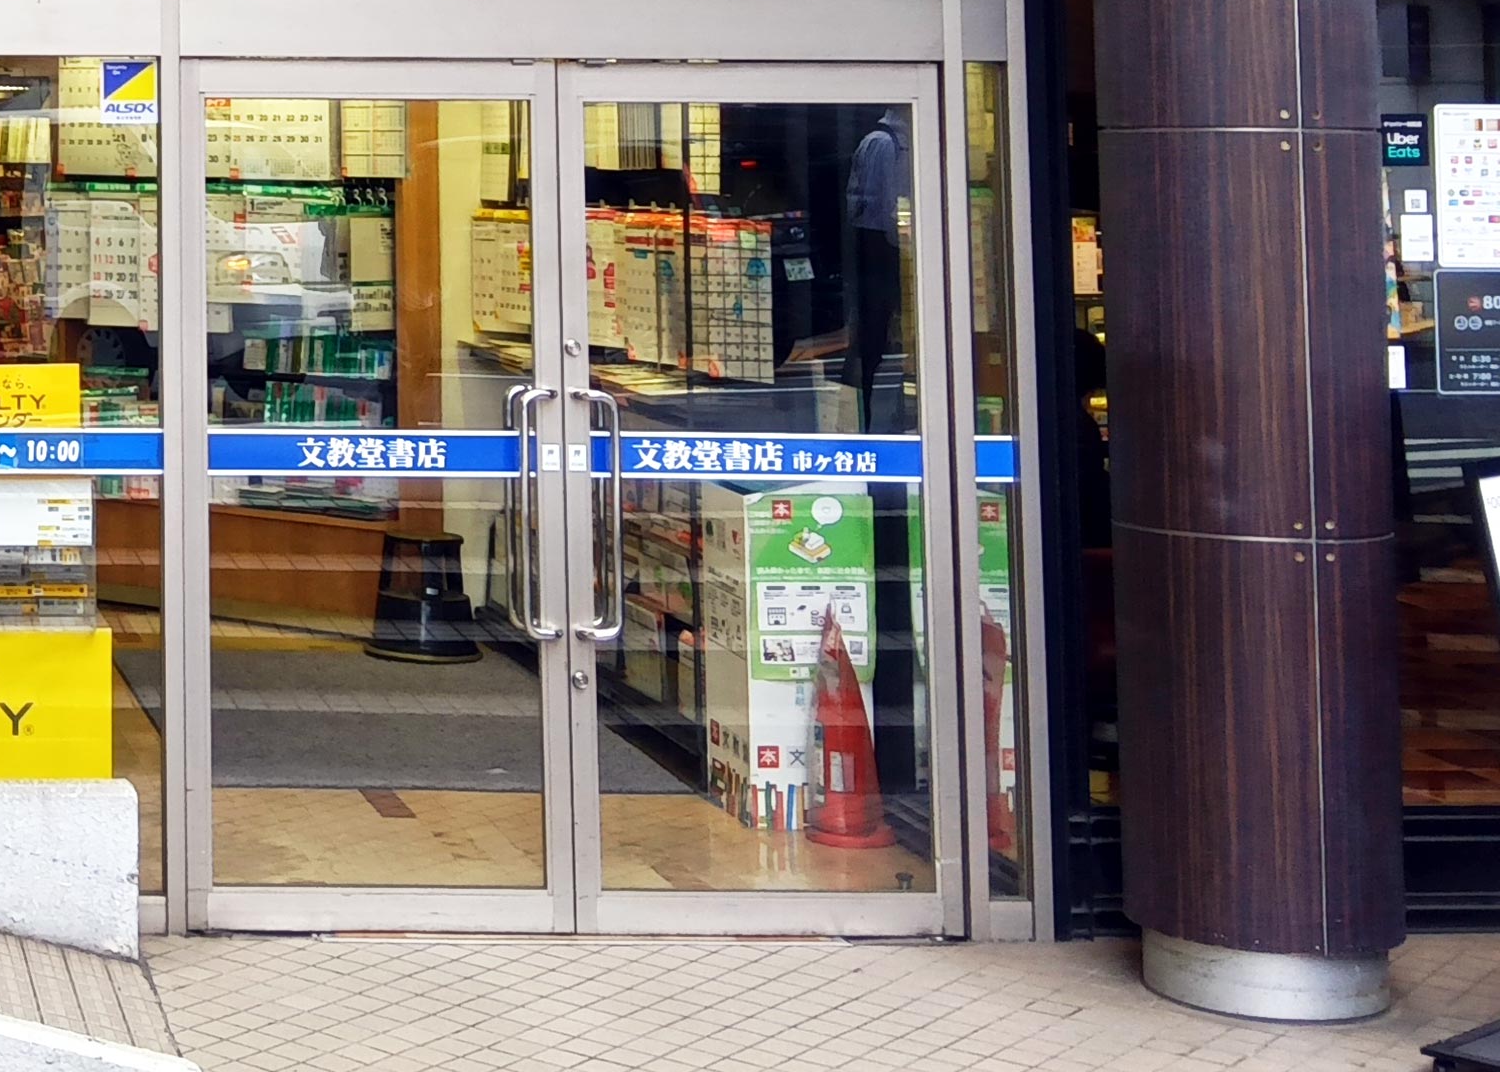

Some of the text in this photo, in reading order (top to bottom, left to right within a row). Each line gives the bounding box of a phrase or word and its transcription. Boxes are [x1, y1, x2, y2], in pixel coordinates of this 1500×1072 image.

[105, 103, 155, 114] ALSOK
[1386, 132, 1420, 145] Uber
[1388, 146, 1420, 158] Eats
[26, 439, 80, 462] 10:00
[296, 437, 448, 469] 文教堂書店
[632, 439, 785, 472] 文教堂書店
